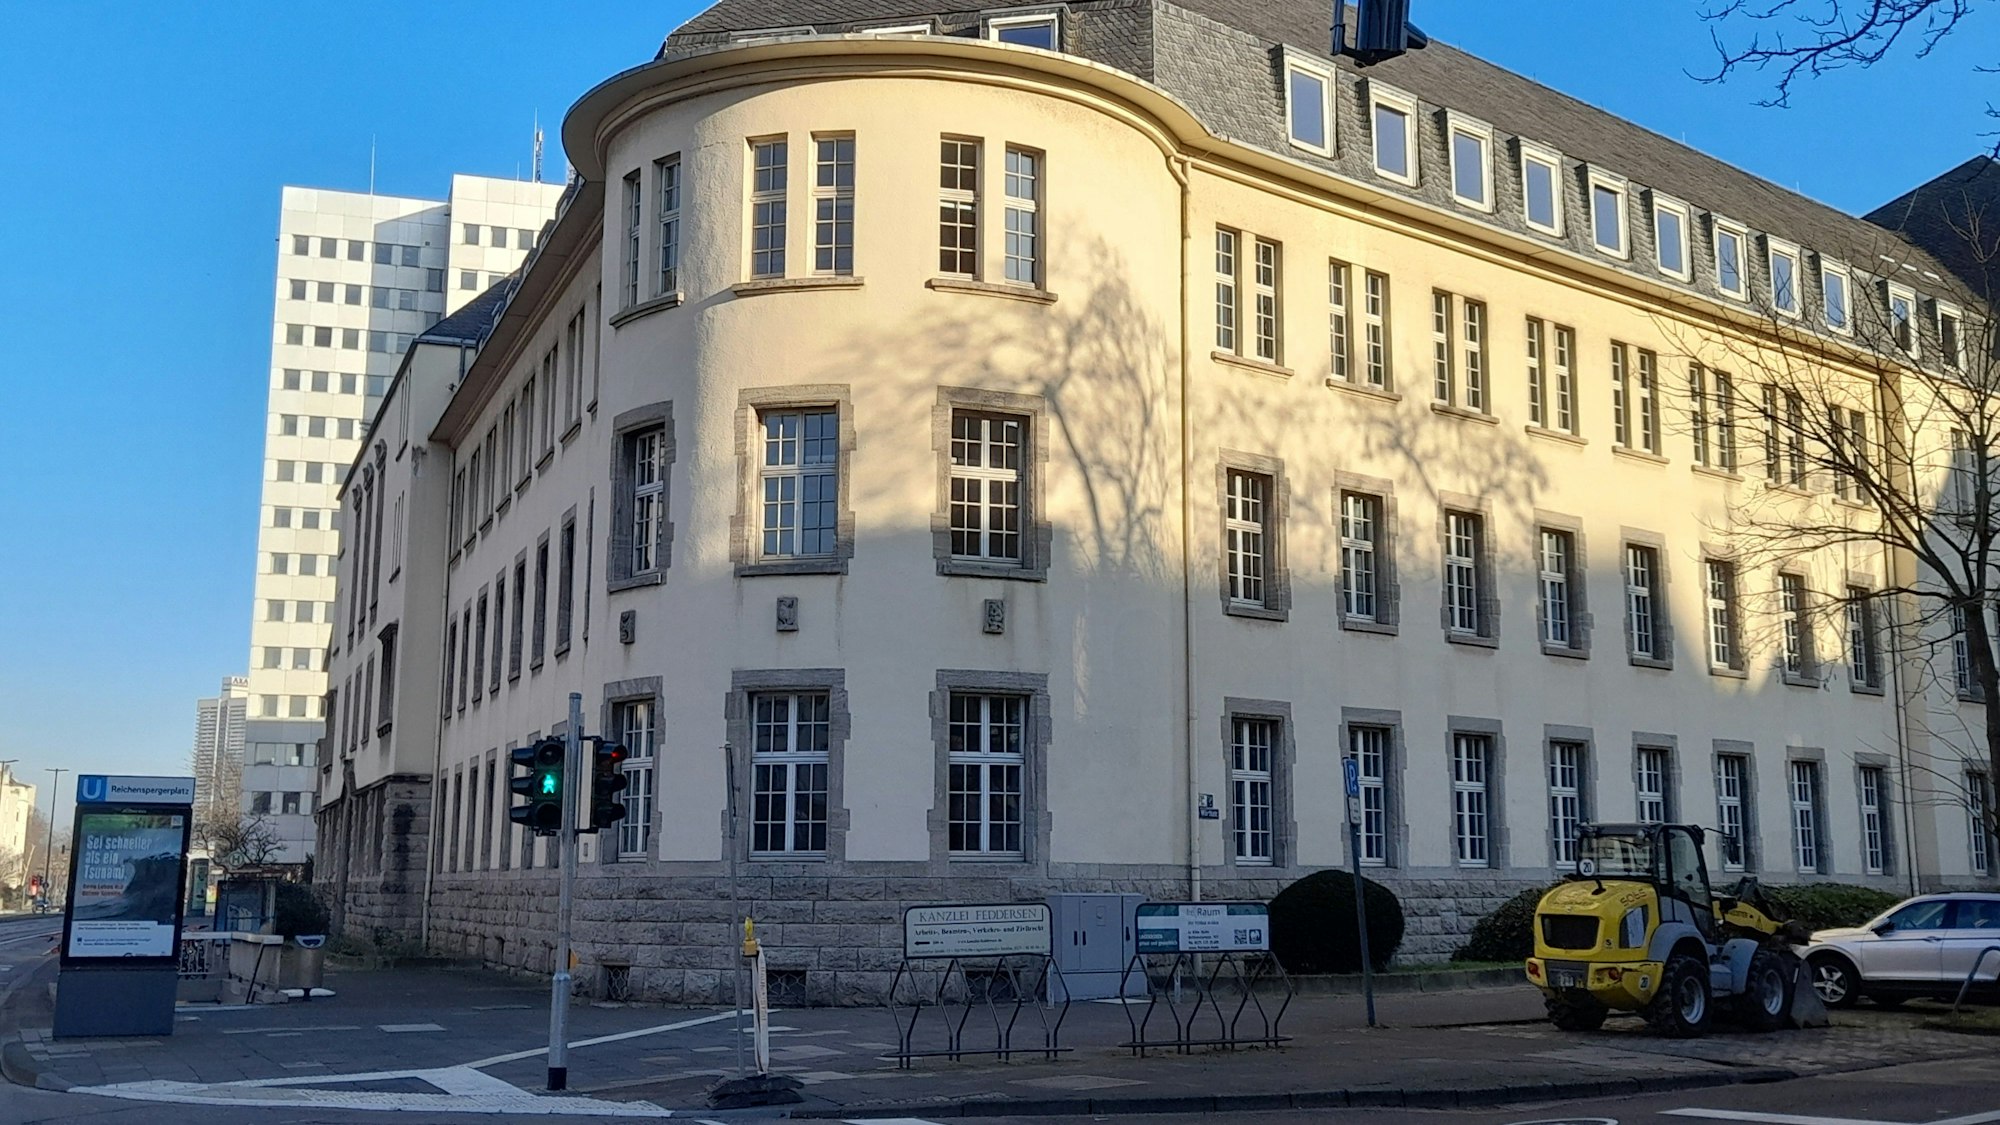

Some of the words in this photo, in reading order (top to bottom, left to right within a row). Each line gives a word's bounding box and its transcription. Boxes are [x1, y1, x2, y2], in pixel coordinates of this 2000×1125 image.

[83, 778, 101, 799] U
[111, 785, 189, 796] Reichenspergerplatz
[86, 835, 102, 849] Sei
[105, 835, 152, 850] schneller
[85, 851, 100, 864] als
[103, 851, 119, 864] ein
[232, 855, 240, 864] H
[84, 865, 127, 880] Tsunami.
[1583, 862, 1592, 873] 20
[919, 910, 969, 922] KANZLEI
[976, 908, 1037, 921] FEDDERSEN
